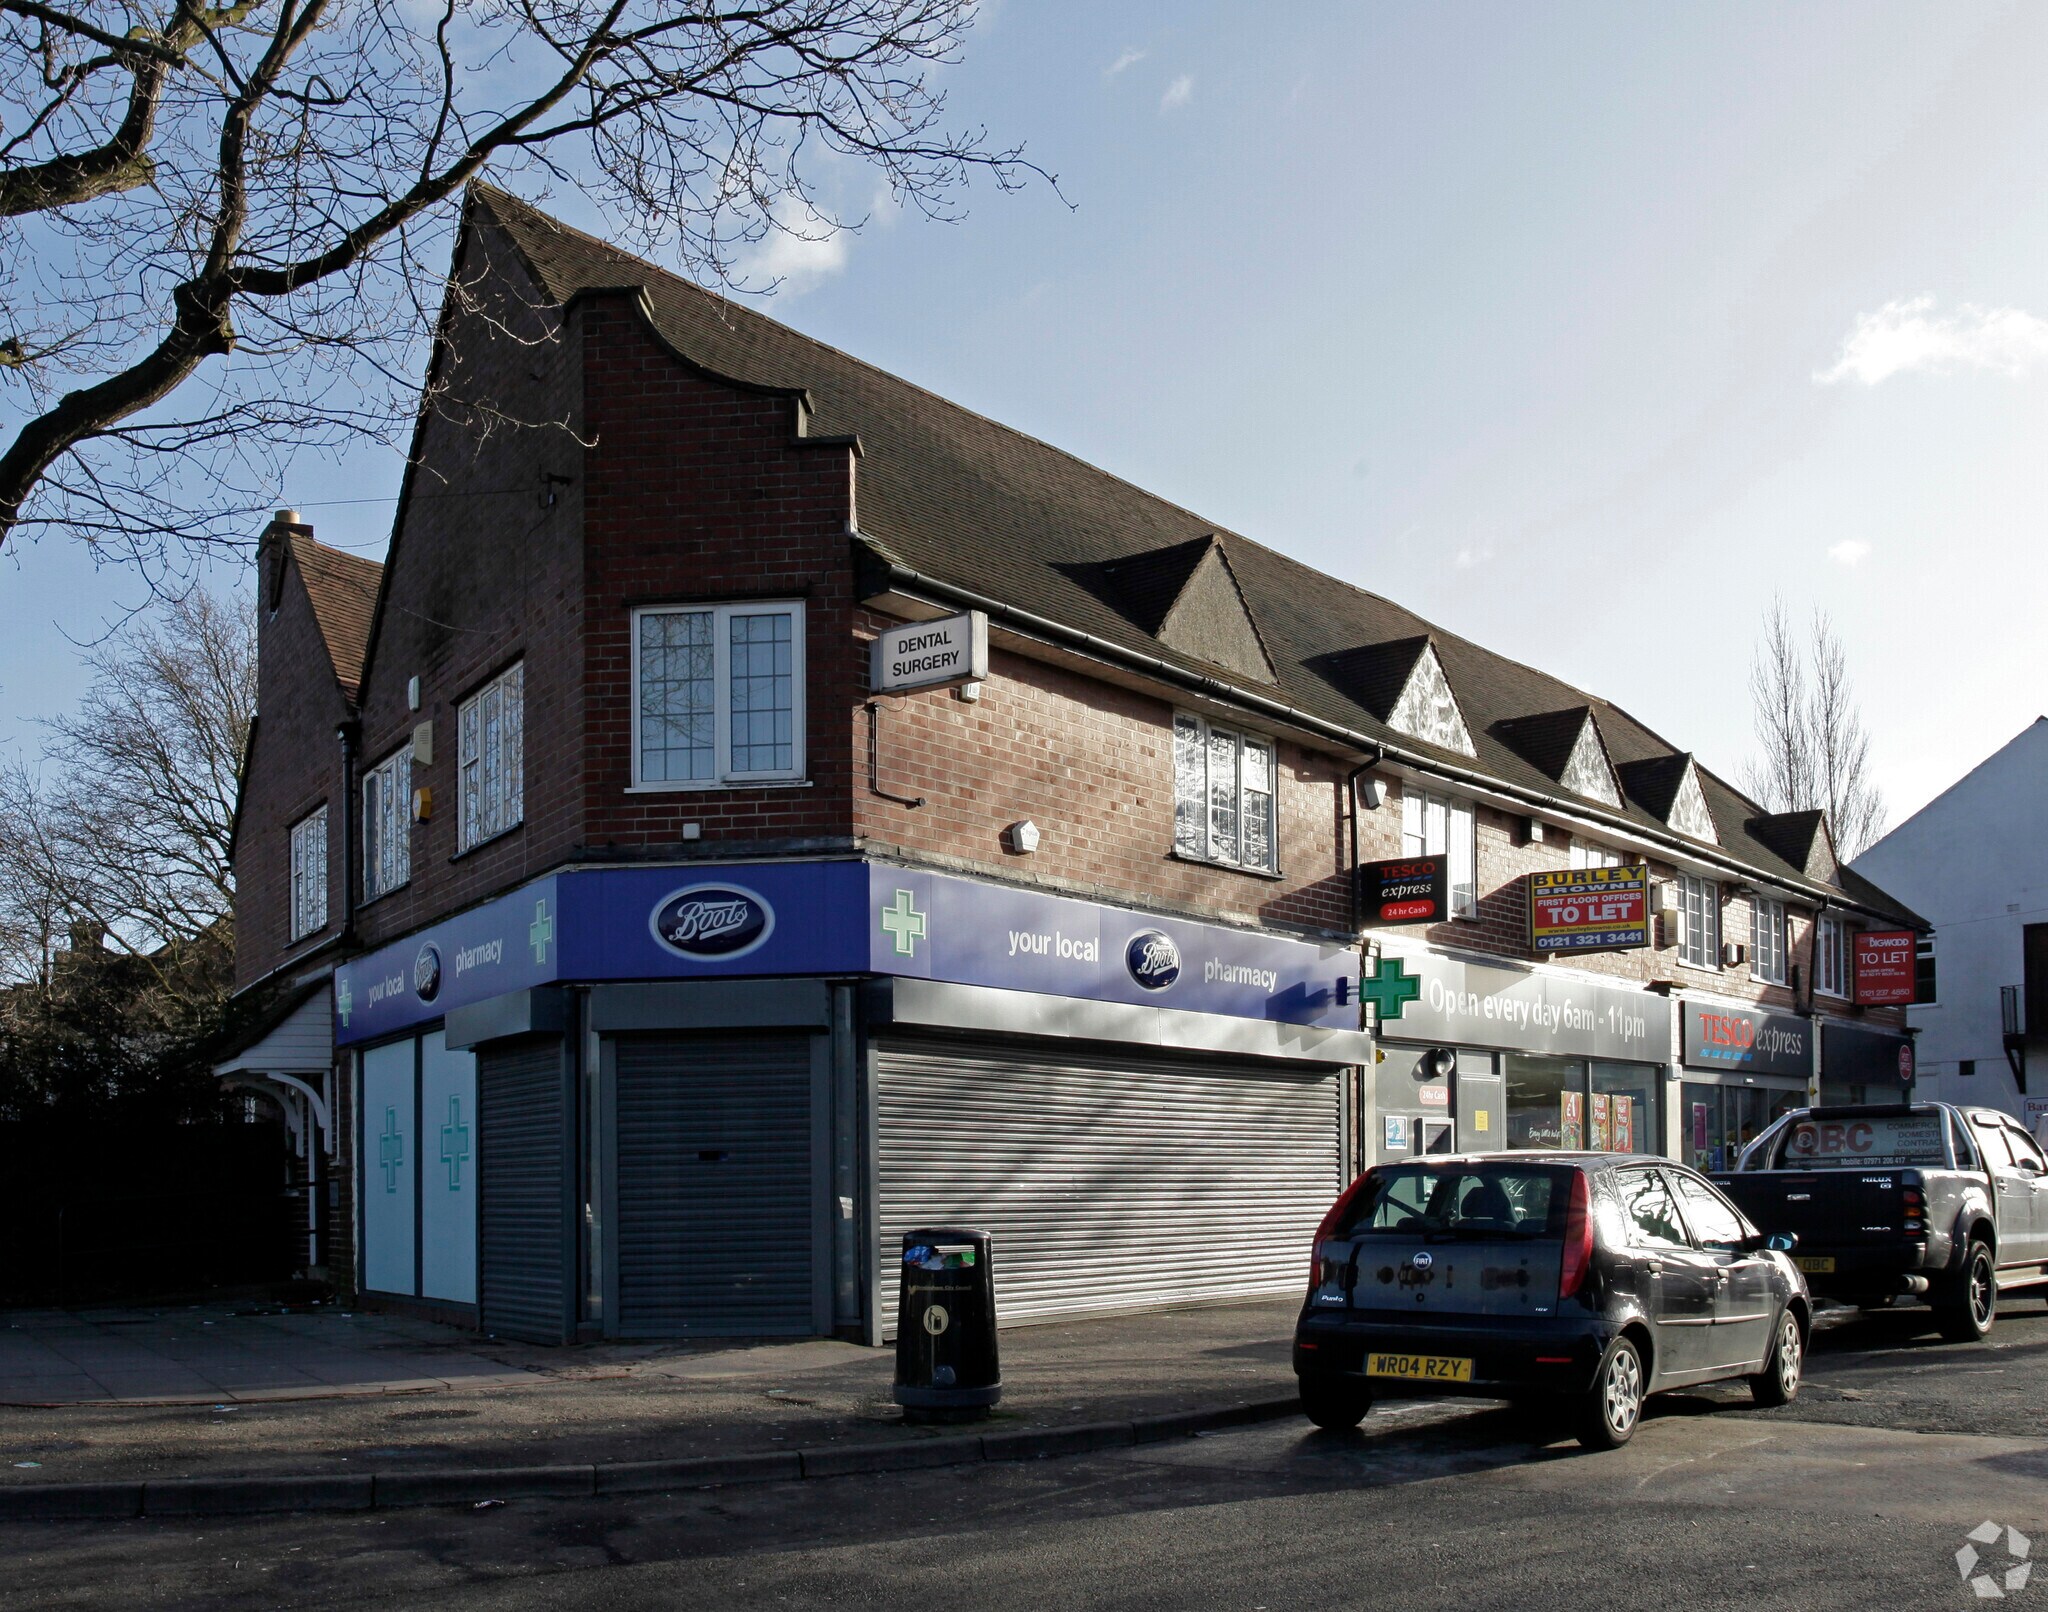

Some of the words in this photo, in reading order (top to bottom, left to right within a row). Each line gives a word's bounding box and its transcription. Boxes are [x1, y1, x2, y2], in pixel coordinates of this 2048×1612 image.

[898, 630, 952, 654] DENTAL
[892, 650, 960, 676] SURGERY
[1380, 861, 1436, 878] TESCO
[1533, 866, 1642, 886] BURLEY
[1381, 883, 1432, 899] express
[1536, 881, 1640, 895] BROWNE
[1537, 898, 1564, 907] FIRST
[1567, 896, 1598, 905] FLOOR
[1601, 892, 1642, 902] OFFICES
[1388, 908, 1397, 916] 24
[1398, 907, 1407, 915] hr
[1408, 906, 1427, 914] Cash
[1547, 906, 1580, 924] TO
[1588, 902, 1632, 921] LET
[668, 899, 748, 941] Boots
[1537, 936, 1570, 947] 0121
[1576, 934, 1601, 945] 321
[1607, 931, 1642, 943] 3441
[1008, 930, 1051, 956] your
[1056, 931, 1098, 962] local
[1137, 942, 1179, 977] Boots
[1204, 957, 1277, 993] pharmacy
[1859, 952, 1879, 965] TO
[1883, 951, 1909, 964] LET
[368, 980, 384, 1008] your
[386, 970, 404, 998] local
[455, 938, 503, 978] pharmacy
[1429, 977, 1479, 1022] Open
[1483, 994, 1530, 1031] every
[1532, 994, 1560, 1034] day
[1563, 999, 1595, 1031] 6am
[1608, 1005, 1645, 1042] 11pm
[1699, 1013, 1753, 1048] TESCO
[1756, 1025, 1802, 1062] express
[1434, 1090, 1446, 1100] Cash
[1595, 1097, 1605, 1108] Half
[1594, 1109, 1606, 1120] Price
[1617, 1113, 1628, 1123] Price
[1791, 1122, 1873, 1157] QBC
[1898, 1130, 1939, 1139] DOMESTI
[1840, 1158, 1862, 1166] Mobile:
[1415, 1257, 1429, 1265] FIAT
[1321, 1294, 1344, 1302] Punto
[1376, 1355, 1420, 1375] WR04
[1425, 1359, 1462, 1378] RZY
